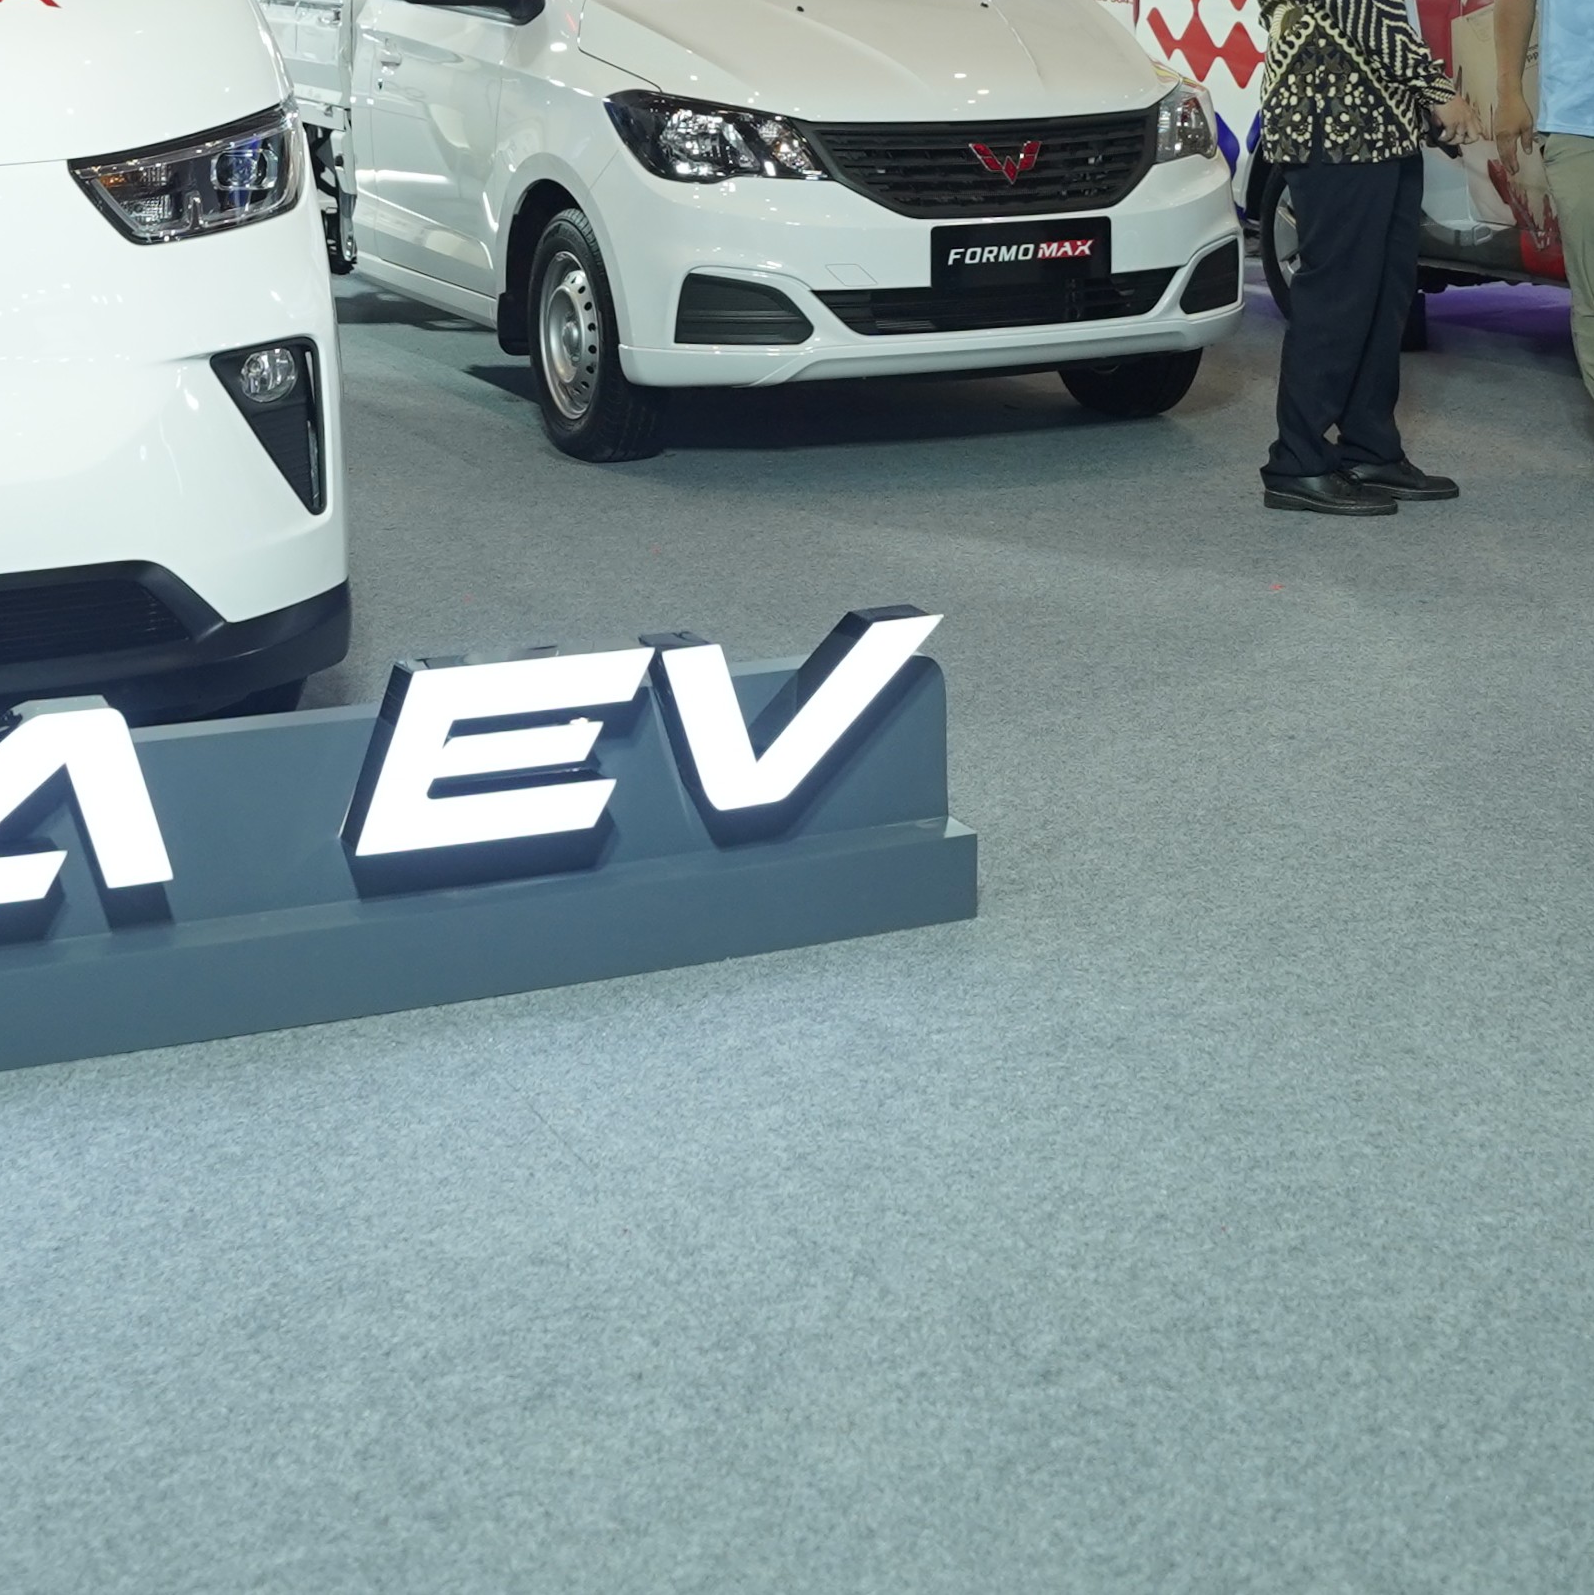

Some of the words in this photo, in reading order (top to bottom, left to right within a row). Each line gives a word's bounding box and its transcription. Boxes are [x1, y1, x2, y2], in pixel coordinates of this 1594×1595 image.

[948, 244, 1034, 265] FORMO
[1037, 239, 1095, 258] MAX
[356, 614, 945, 856] EV
